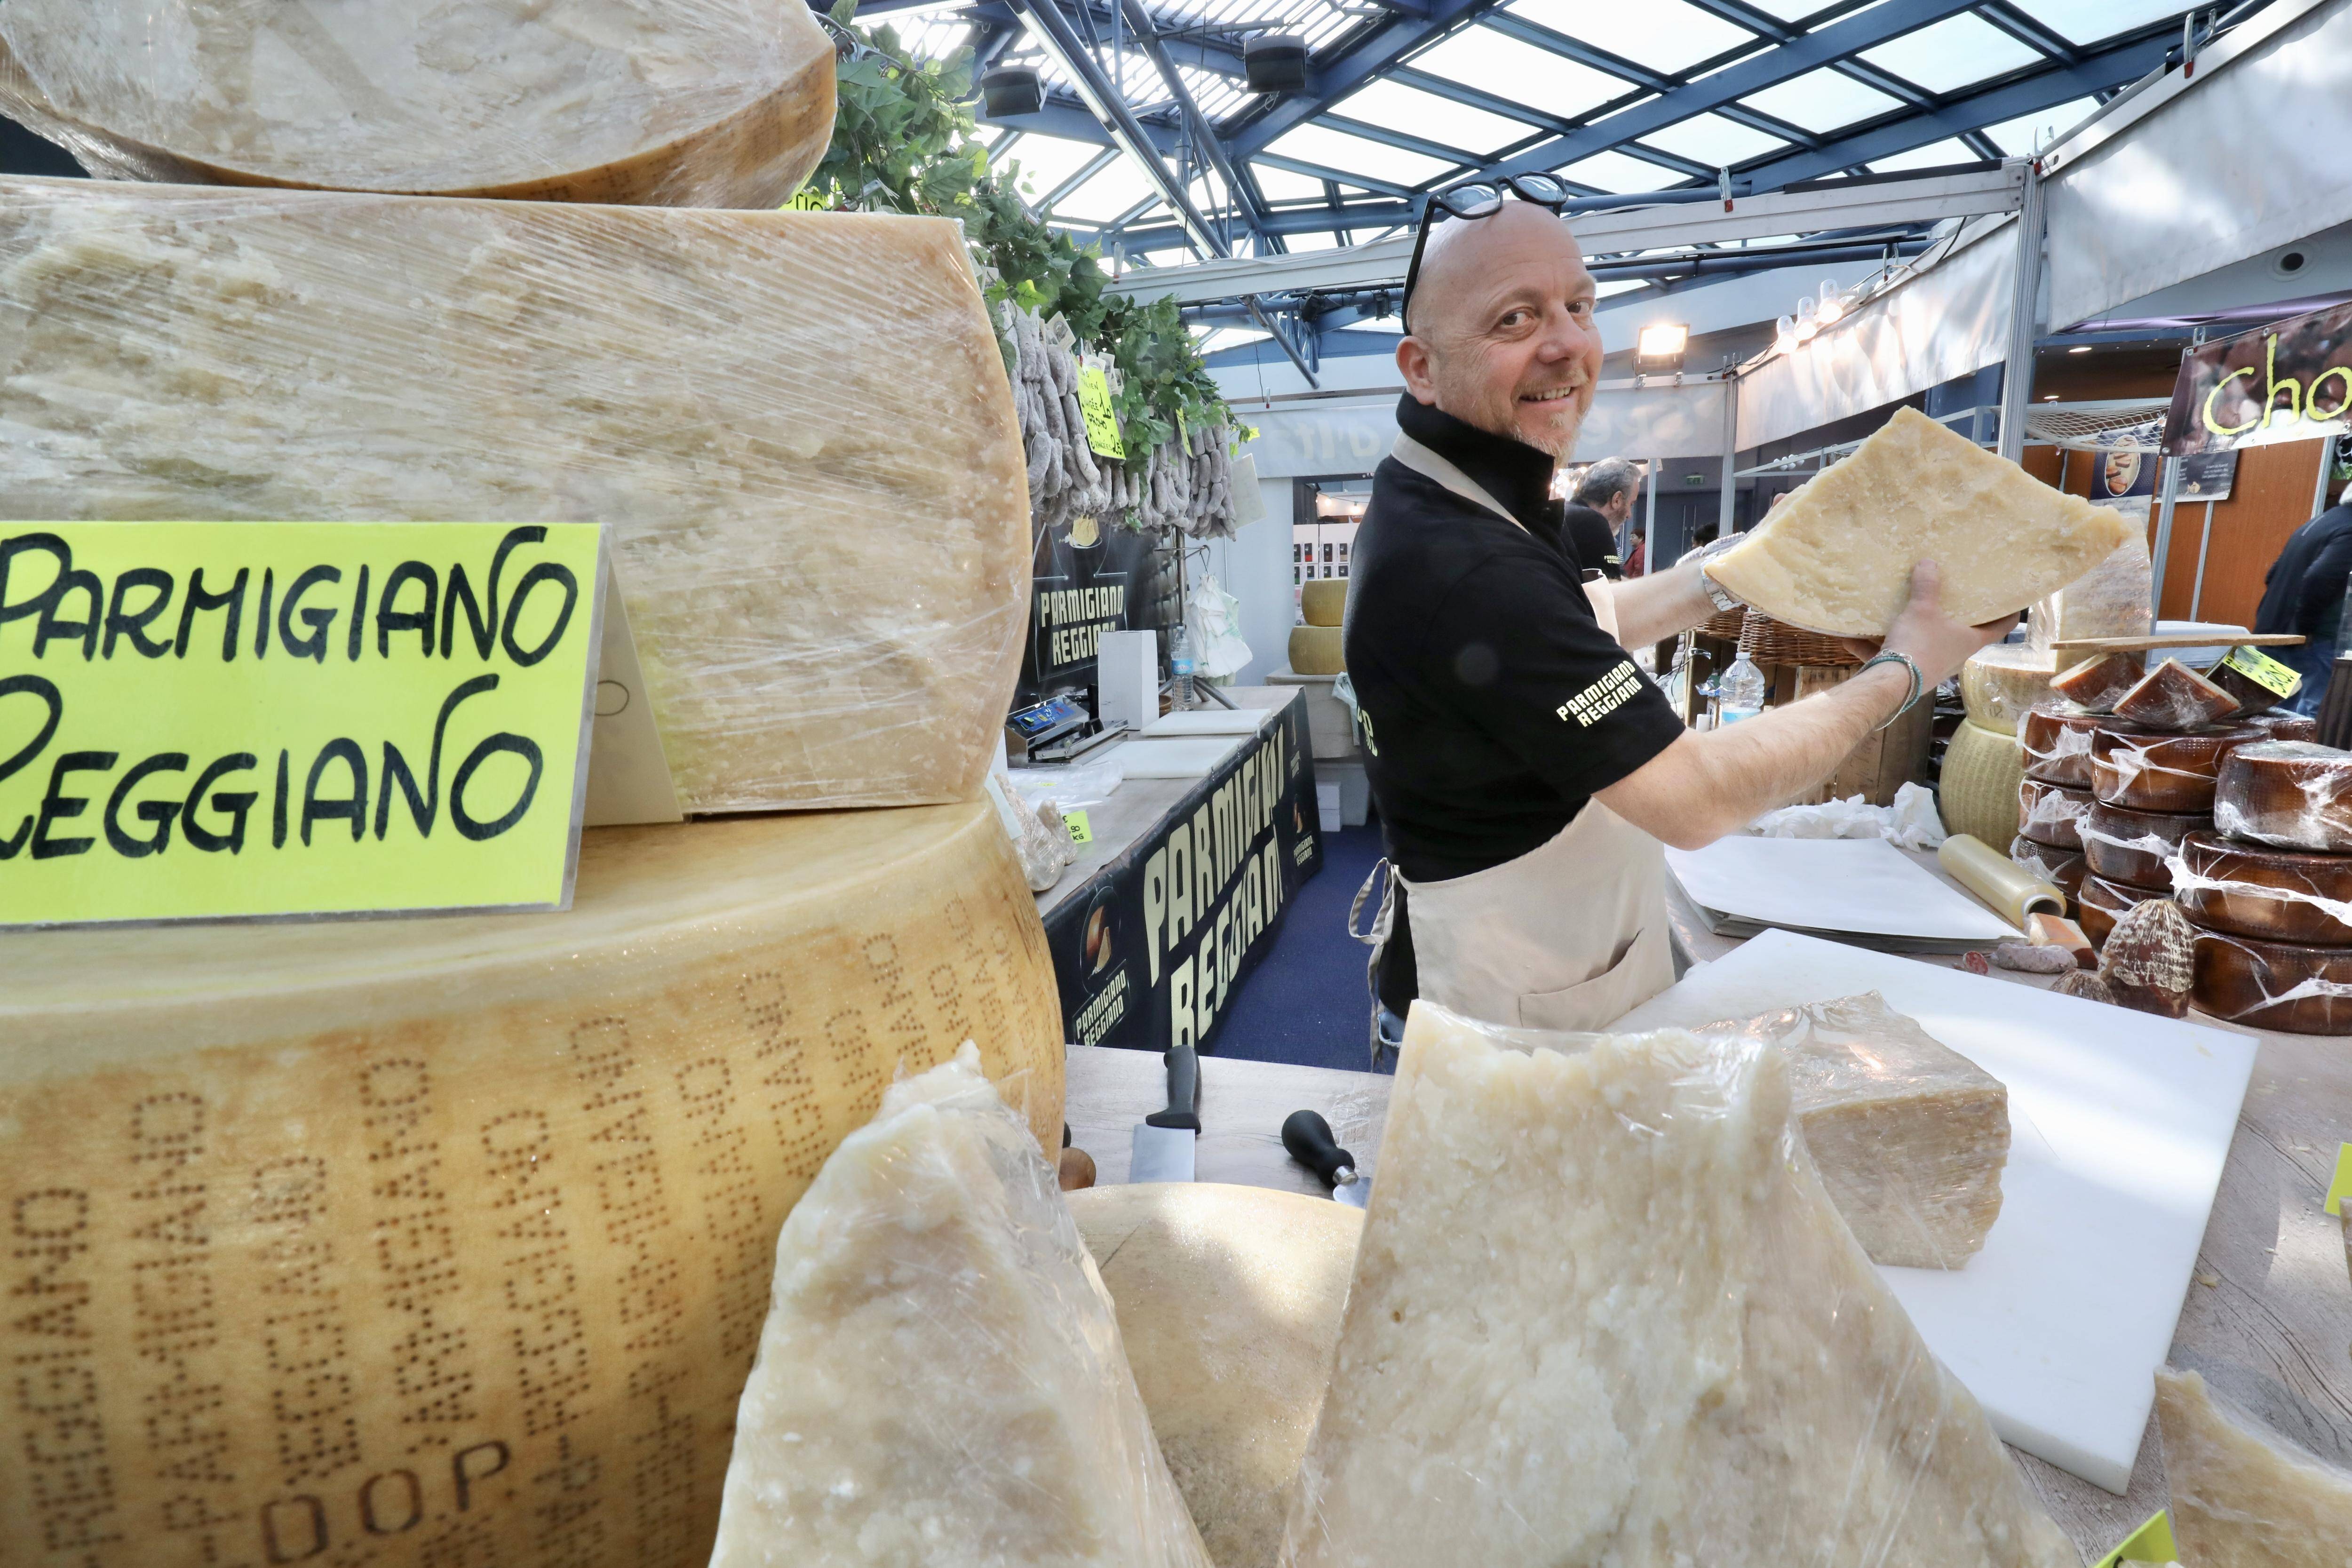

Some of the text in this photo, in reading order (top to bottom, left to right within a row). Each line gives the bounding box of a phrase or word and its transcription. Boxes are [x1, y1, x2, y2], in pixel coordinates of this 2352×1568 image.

[0, 525, 579, 667] PARMIGIANO
[1041, 585, 1124, 628] PARMIGIANO
[1052, 621, 1116, 666] REGGIA
[1556, 660, 1636, 722] PARMIGIANO
[1577, 676, 1643, 728] REGGIANO
[1076, 969, 1126, 1040] PARMIGIANO
[1083, 995, 1124, 1047] REGGIANO
[358, 1057, 477, 1455] ARMIGIANO
